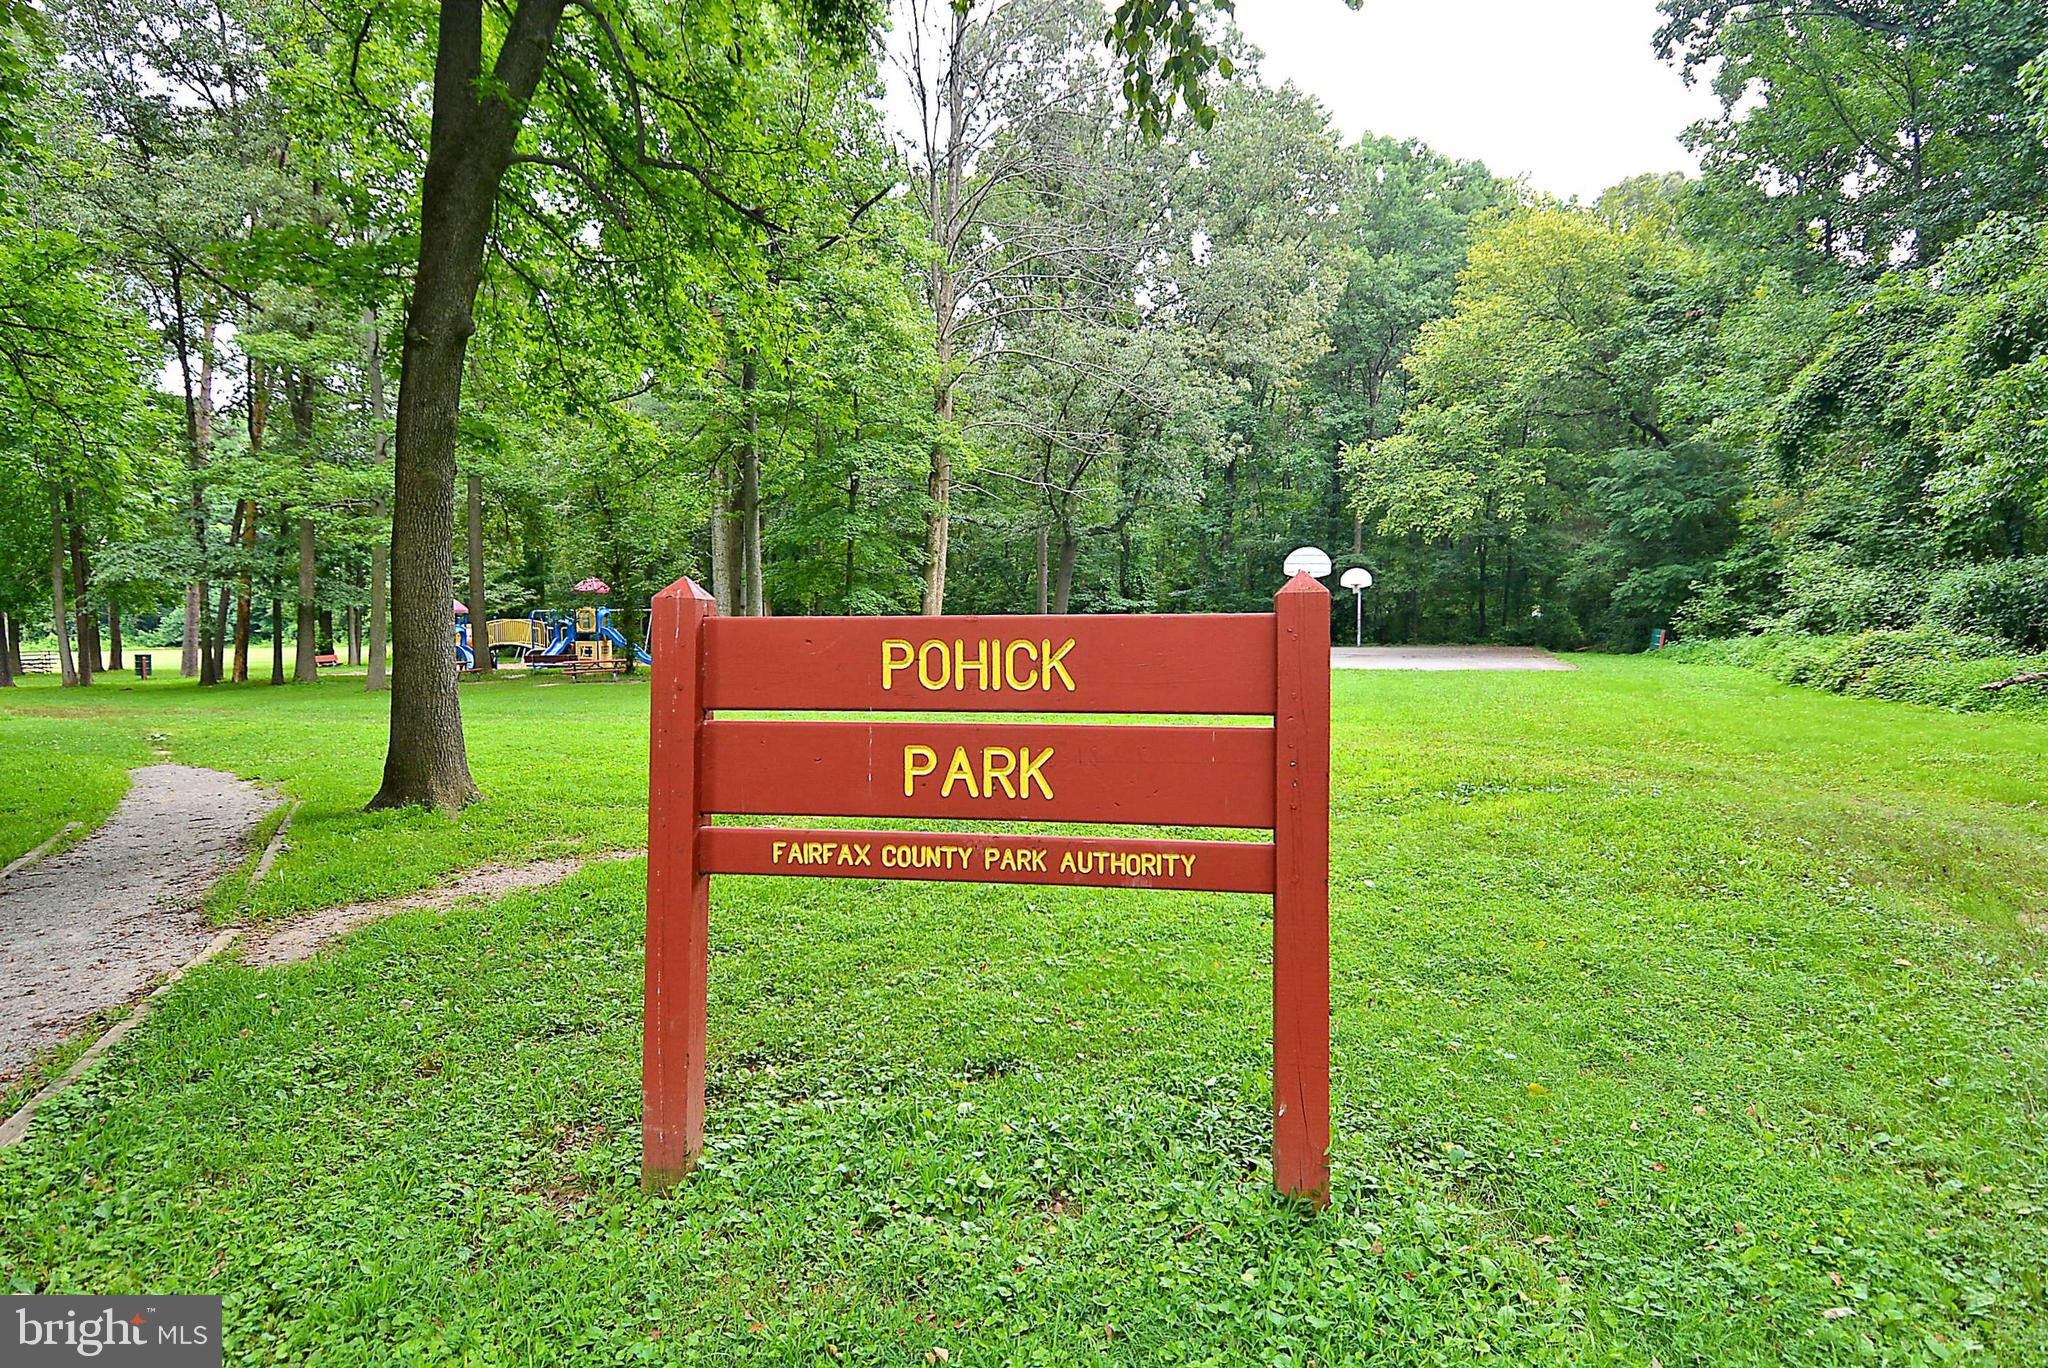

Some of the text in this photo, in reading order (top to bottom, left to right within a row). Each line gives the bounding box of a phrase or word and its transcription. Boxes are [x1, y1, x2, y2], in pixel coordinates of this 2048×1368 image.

[880, 637, 1077, 692] POHICK
[902, 743, 1056, 800] PARK
[771, 840, 1198, 878] FAIRFAX COUNTY PARK AUTHORITY
